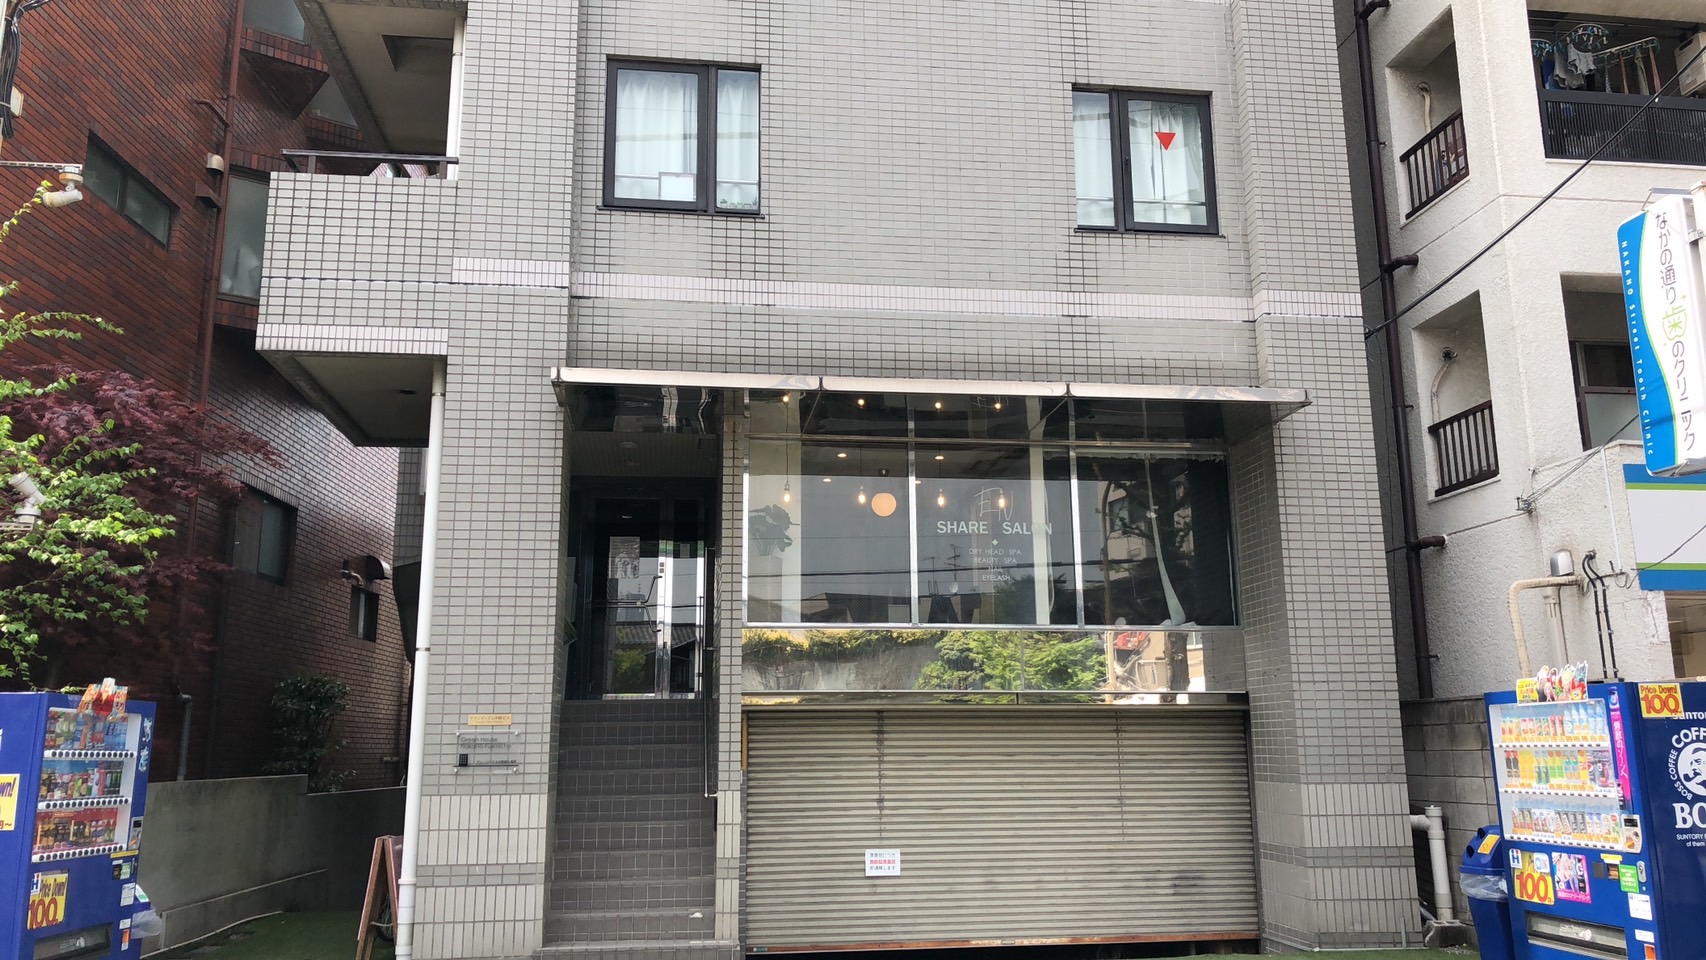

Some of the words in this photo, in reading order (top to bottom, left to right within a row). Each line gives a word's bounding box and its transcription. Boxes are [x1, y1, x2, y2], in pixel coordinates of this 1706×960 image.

[1655, 212, 1696, 451] なかの通り歯のクリニック
[1621, 240, 1634, 296] NAKANO
[1629, 303, 1640, 351] Street
[1636, 358, 1647, 401] Tooth
[1643, 409, 1654, 455] Clinic
[936, 520, 988, 534] SHARE
[1002, 521, 1052, 535] SALON
[968, 548, 982, 556] DRY
[985, 548, 1004, 556] HEAD
[1008, 548, 1022, 556] SPA
[1641, 685, 1657, 694] Price
[1641, 693, 1680, 715] 100
[1667, 748, 1679, 780] COFFEE
[1674, 781, 1693, 801] BOSS
[1516, 871, 1549, 903] 100
[29, 897, 58, 929] 100
